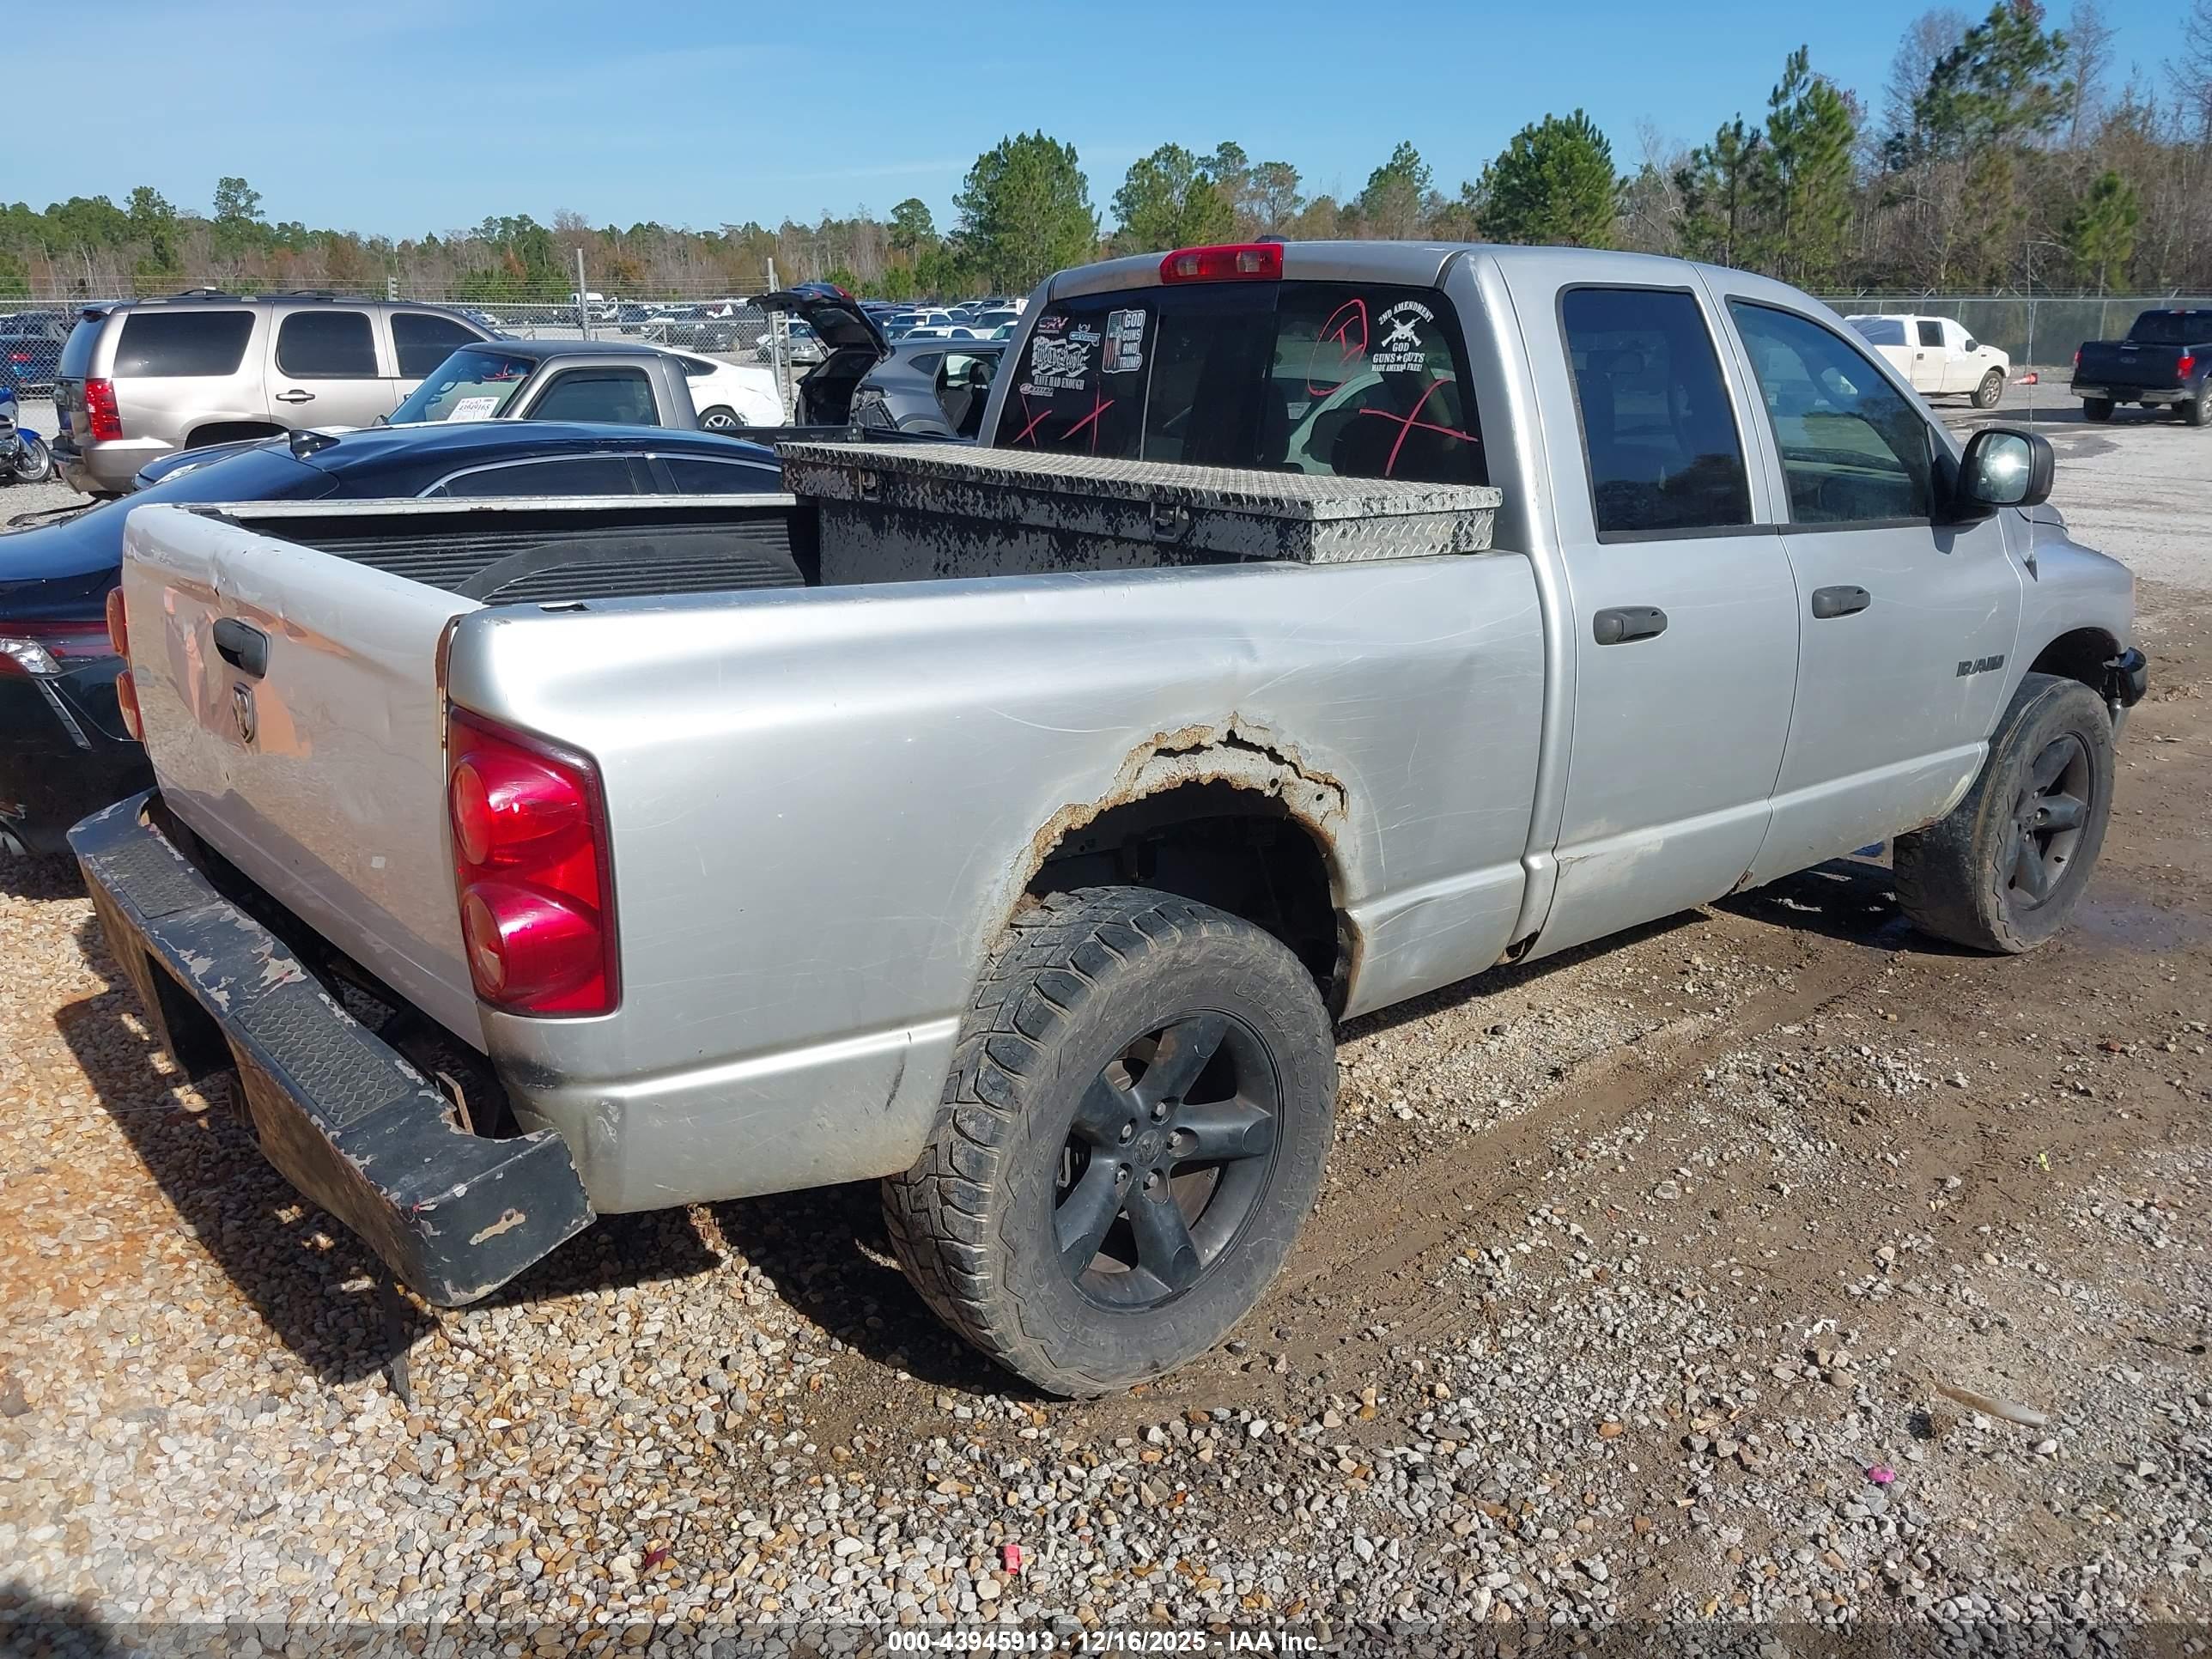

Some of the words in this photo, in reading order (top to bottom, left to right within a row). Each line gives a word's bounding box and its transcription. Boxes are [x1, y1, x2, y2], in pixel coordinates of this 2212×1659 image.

[1378, 309, 1392, 325] 2ND
[1393, 301, 1434, 323] AMENDMENT
[1125, 313, 1144, 328] GOD
[1122, 329, 1140, 342] GUNS
[1122, 343, 1138, 355] AND
[1392, 343, 1410, 352] GOD
[1119, 356, 1140, 368] TRUMP
[1373, 353, 1396, 363] GUNS
[1034, 374, 1048, 386] HAVE
[1048, 376, 1061, 387] HAD
[1060, 377, 1085, 390] ENOUGH
[1956, 654, 2005, 678] RAM
